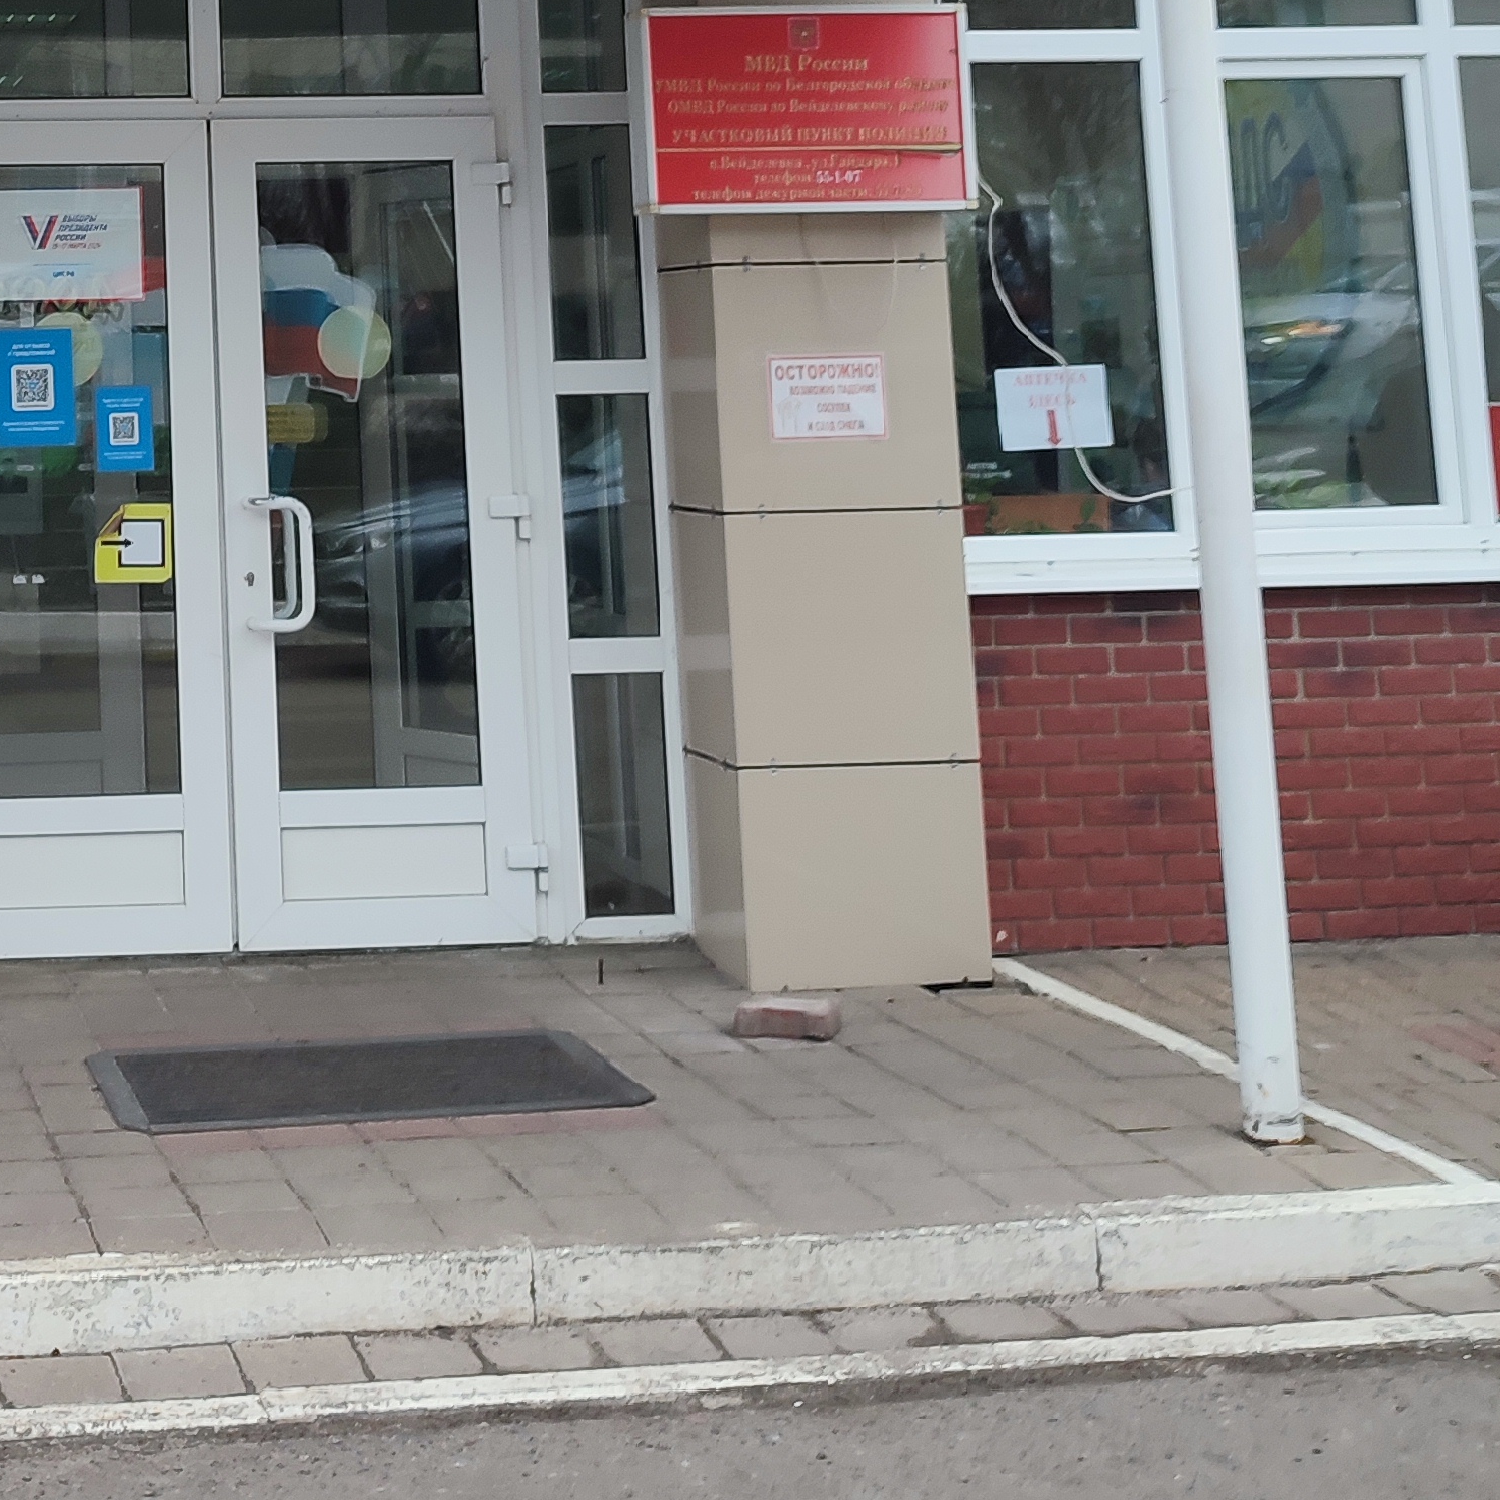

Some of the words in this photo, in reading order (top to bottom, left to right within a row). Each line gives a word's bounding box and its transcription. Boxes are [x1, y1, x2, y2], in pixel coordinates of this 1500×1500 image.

[744, 54, 791, 73] МВД
[797, 54, 868, 71] России
[672, 124, 793, 143] УЧАСТКОВЫЙ
[797, 127, 854, 142] ПУНКТ
